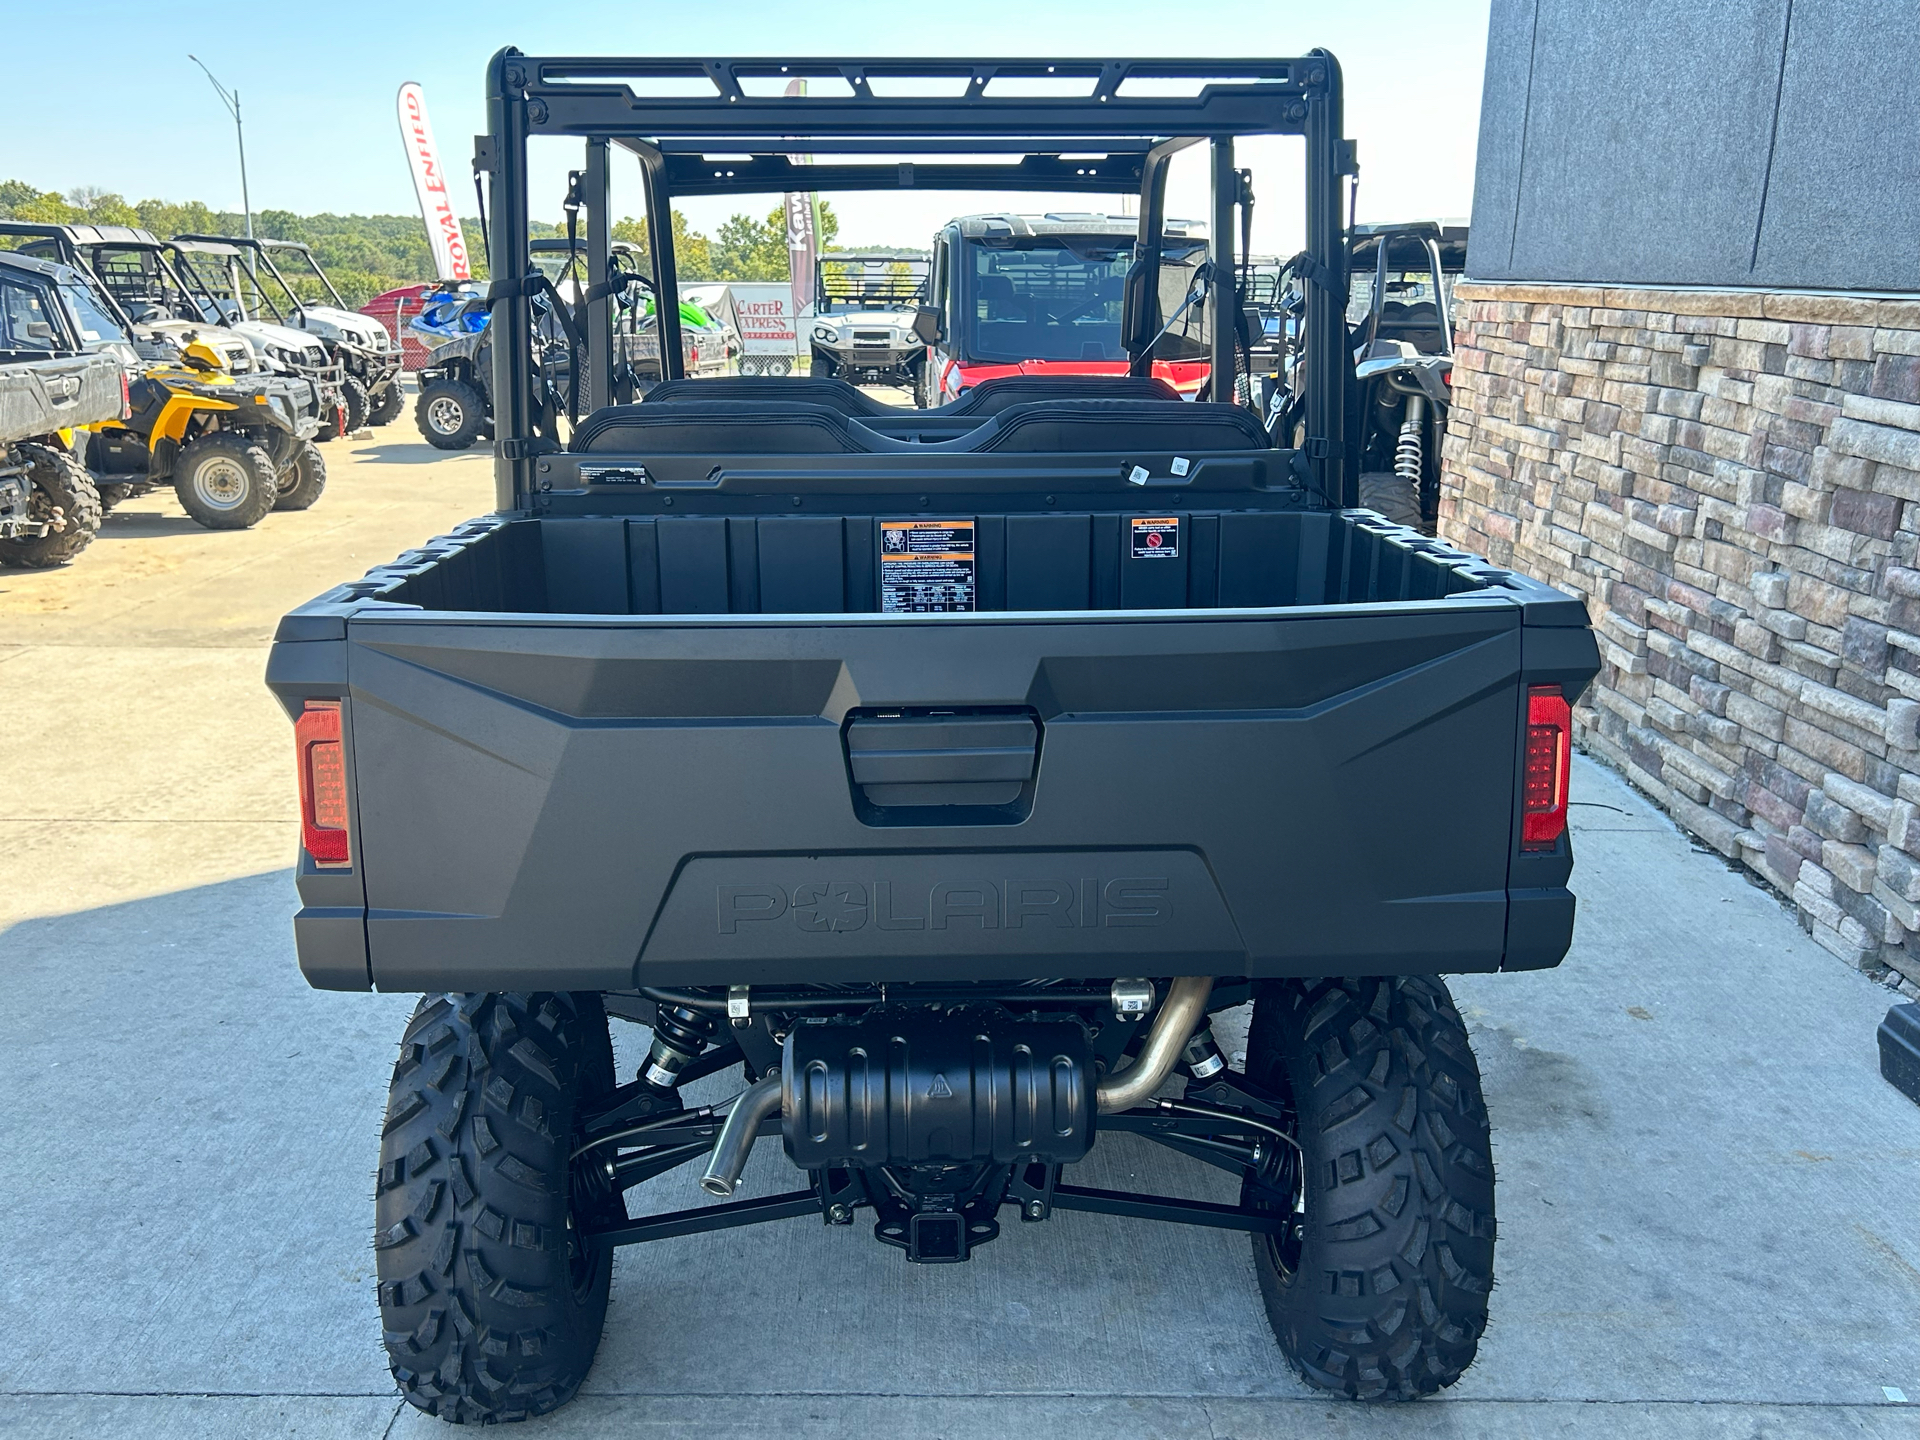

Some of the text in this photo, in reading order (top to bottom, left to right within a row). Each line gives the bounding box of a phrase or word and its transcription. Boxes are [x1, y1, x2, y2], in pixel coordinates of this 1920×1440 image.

[406, 92, 469, 279] ROYAL ENFIELD
[737, 299, 783, 316] CARTER
[716, 877, 1174, 935] POLARIS
